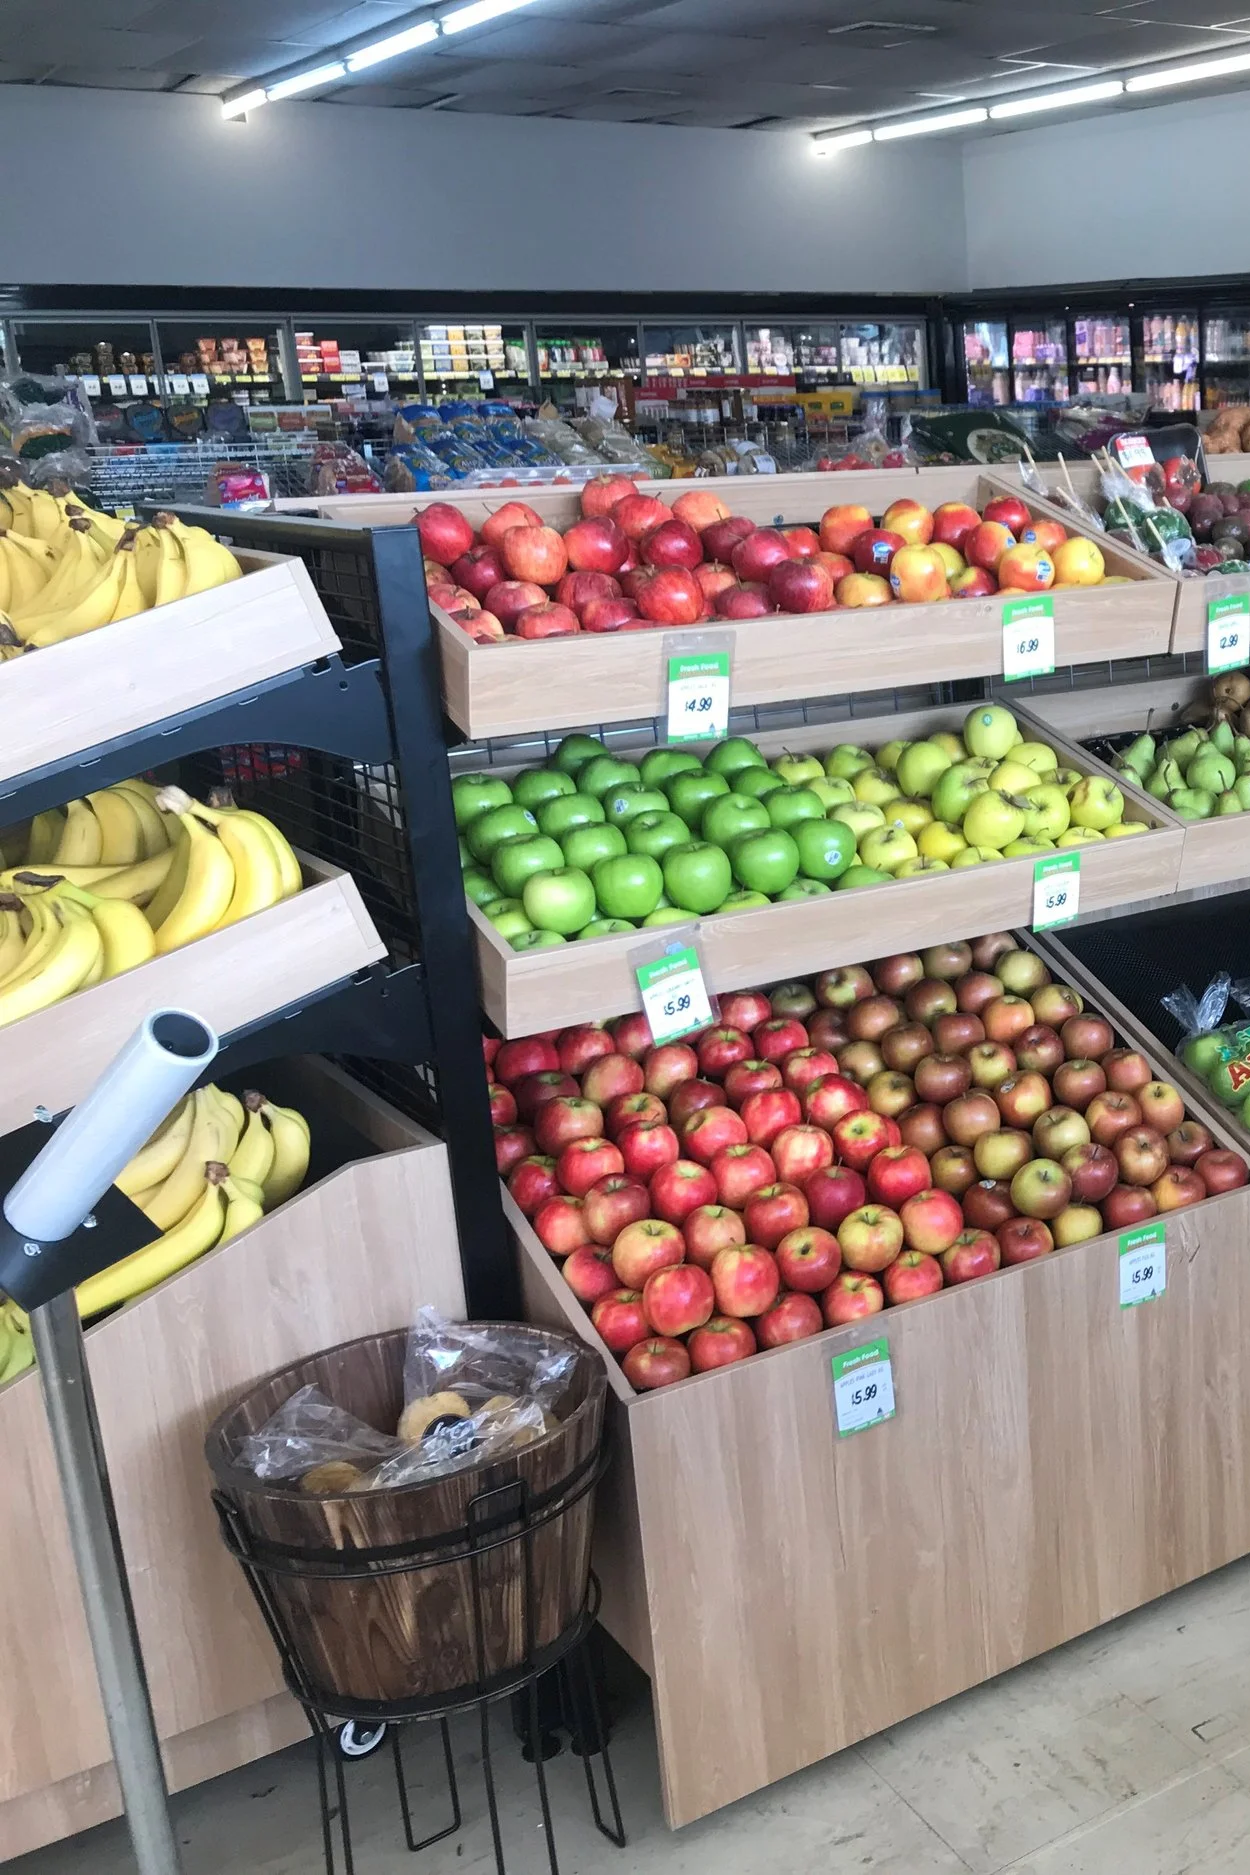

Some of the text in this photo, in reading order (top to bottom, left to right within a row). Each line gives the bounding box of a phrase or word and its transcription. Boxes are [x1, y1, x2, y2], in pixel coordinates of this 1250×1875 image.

[842, 1349, 880, 1369] Fresh Food
[851, 1383, 878, 1406] $5.99
